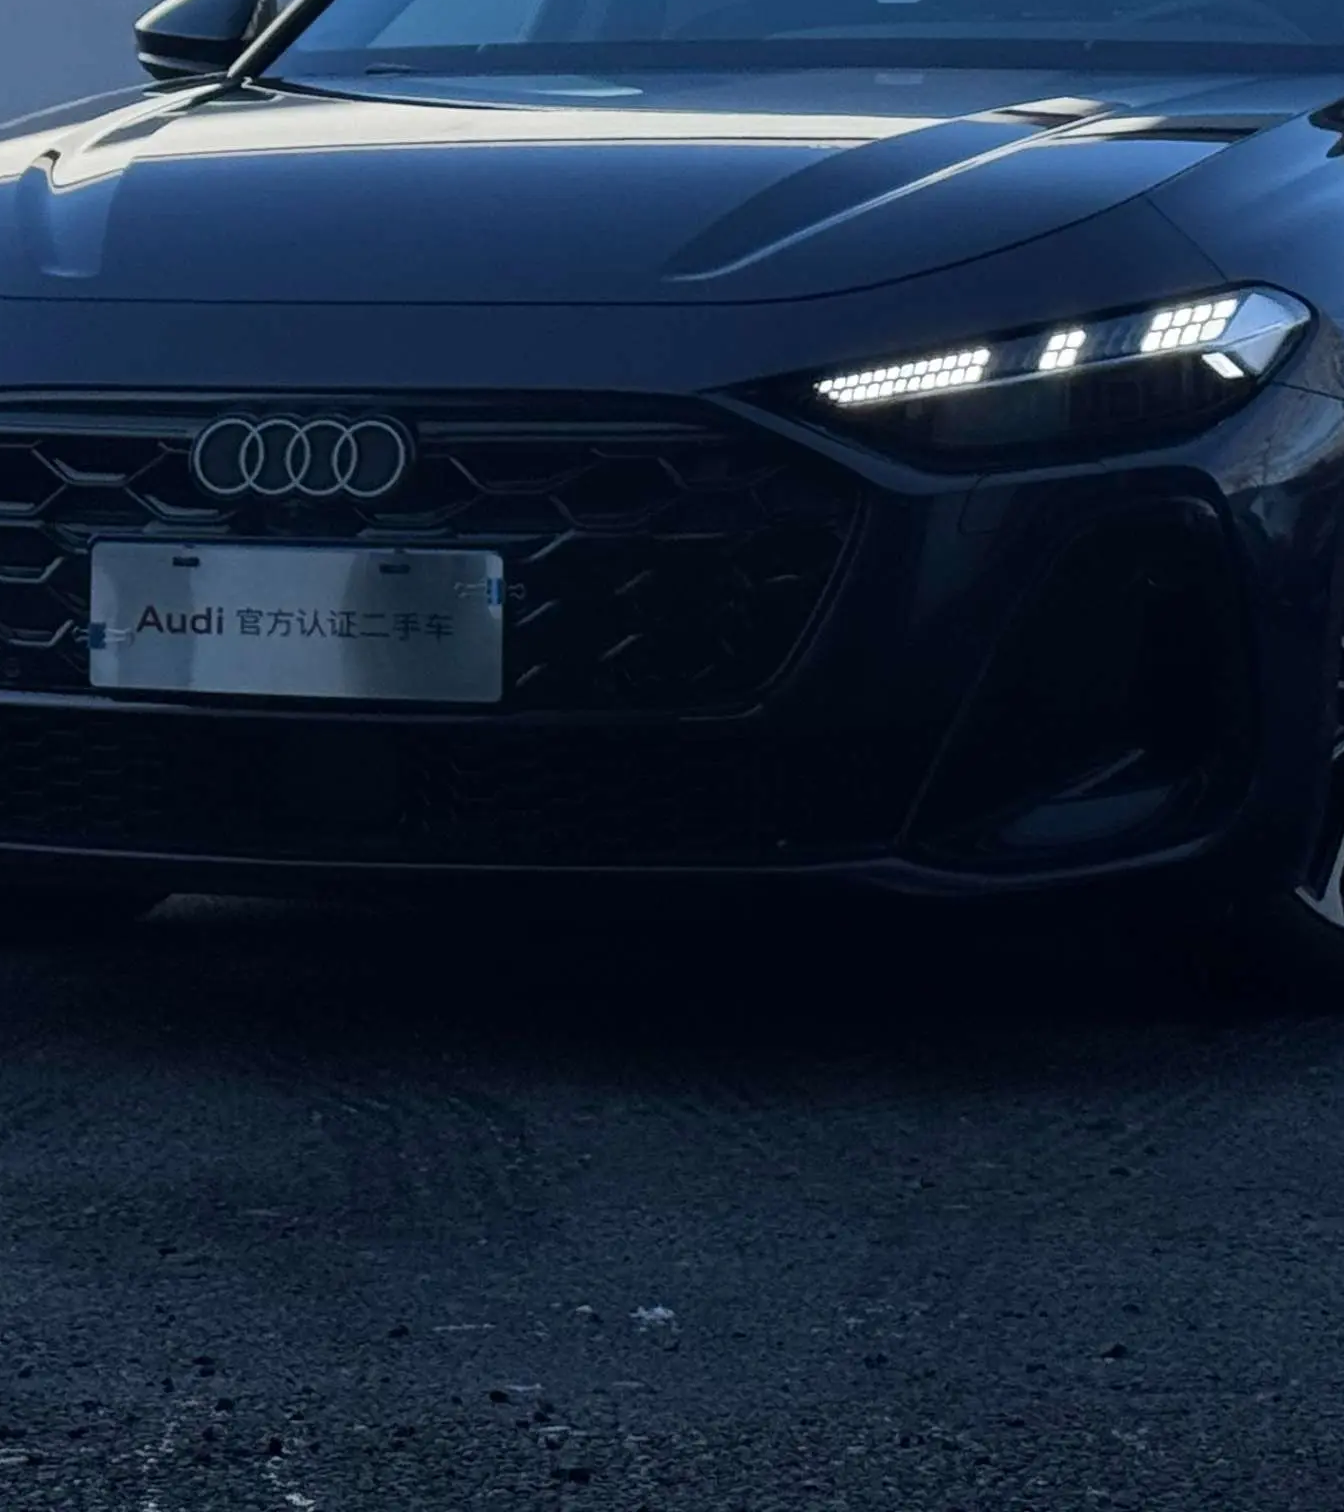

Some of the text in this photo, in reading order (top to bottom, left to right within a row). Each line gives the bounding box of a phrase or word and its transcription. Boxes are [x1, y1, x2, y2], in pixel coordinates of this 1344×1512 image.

[136, 605, 455, 641] Audi 官方认证二手车
